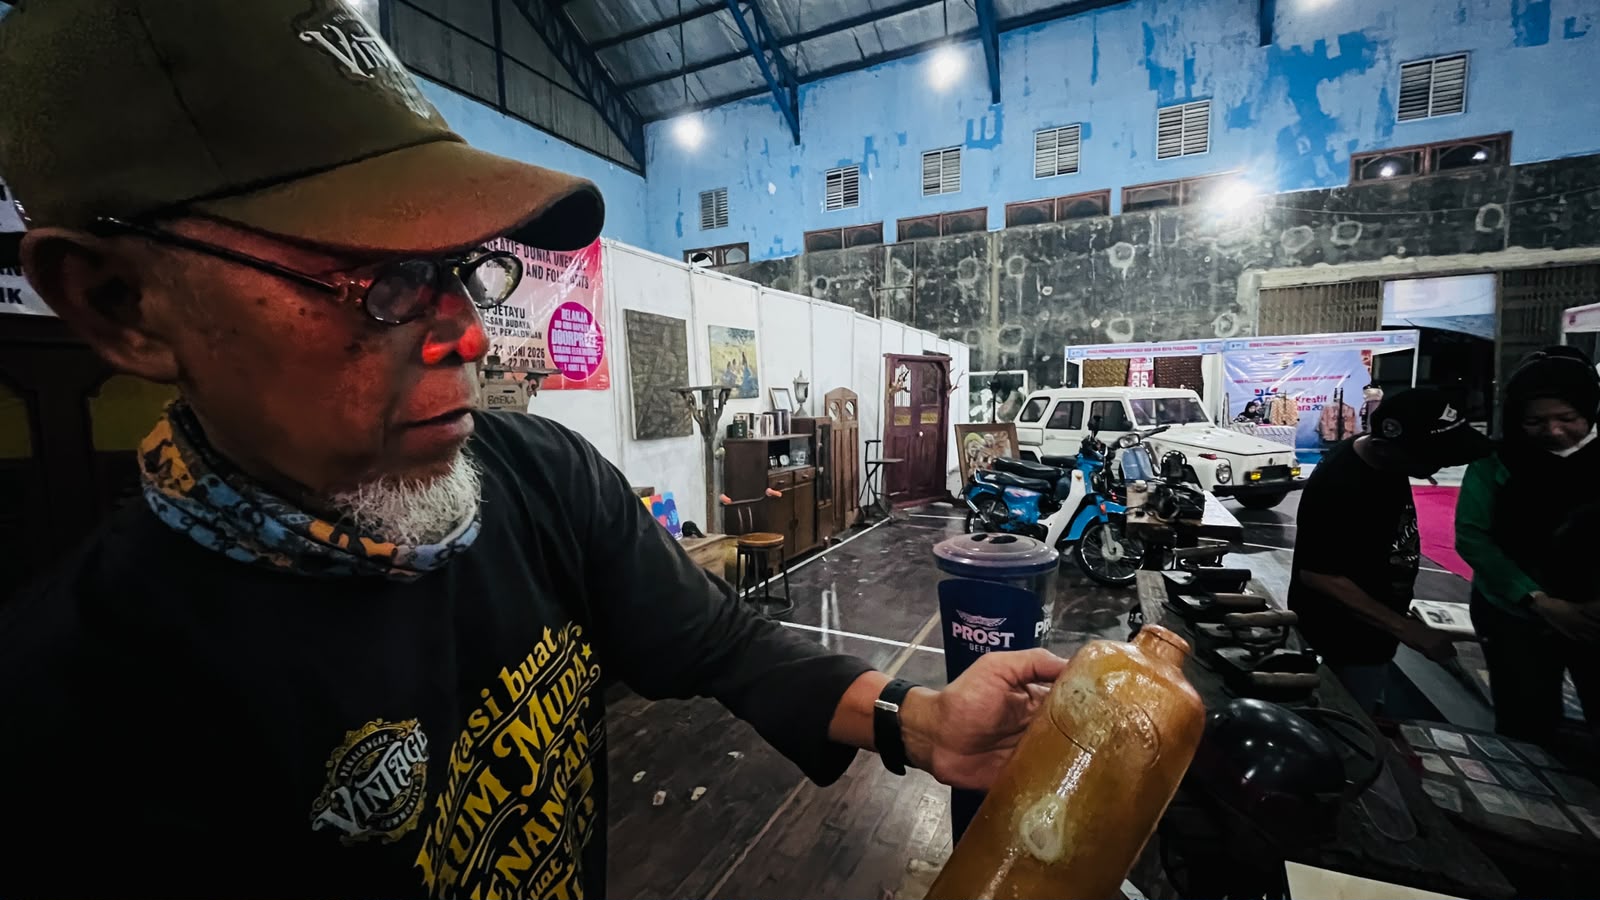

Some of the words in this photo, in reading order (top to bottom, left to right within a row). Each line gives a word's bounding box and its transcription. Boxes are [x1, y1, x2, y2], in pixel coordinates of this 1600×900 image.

[522, 245, 552, 264] DUNIA
[526, 263, 543, 280] AND
[492, 304, 525, 319] JETAYU
[505, 318, 531, 330] BUDAYA
[1295, 395, 1327, 403] Kreatif
[951, 621, 1015, 648] PROST
[497, 625, 559, 703] buat
[492, 651, 588, 798] MUDA
[311, 722, 429, 835] VINTAGE
